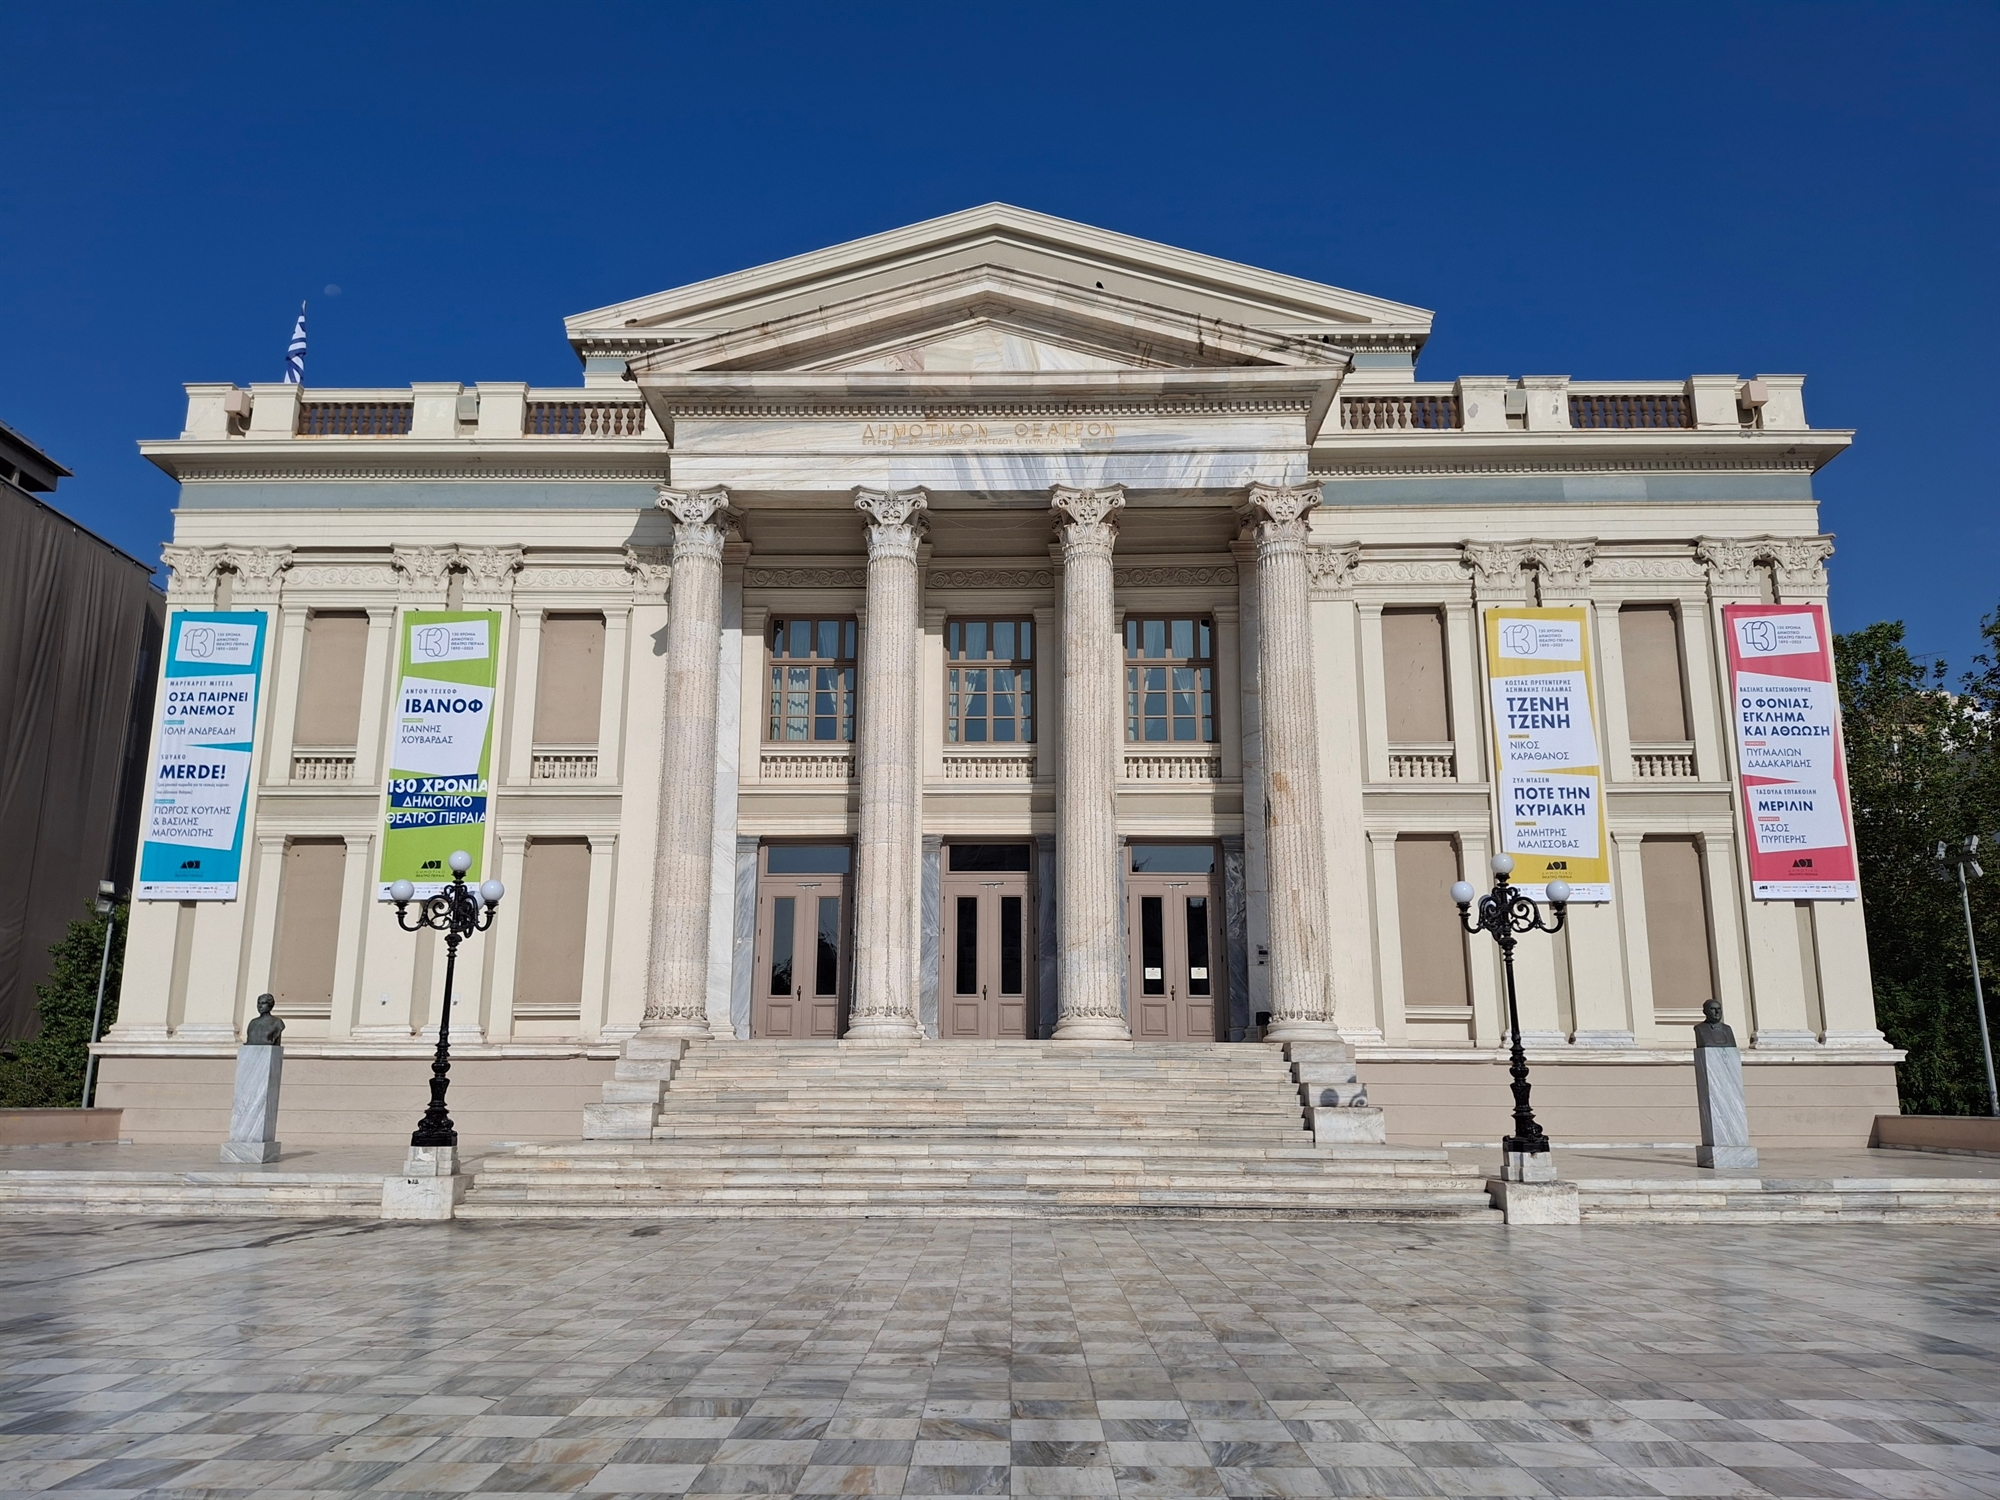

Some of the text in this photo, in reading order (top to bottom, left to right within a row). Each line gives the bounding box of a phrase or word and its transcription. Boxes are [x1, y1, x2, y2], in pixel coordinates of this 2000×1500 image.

[862, 422, 1116, 438] ΔΗΜΟΤΙΚΟΝ ΘΕΑΤΡΟΝ
[168, 691, 249, 702] ΟΣΑ ΠΑΙΡΝΕΙ
[405, 698, 484, 713] ΙΒΑΝΟΦ
[1506, 696, 1569, 712] ΤΖΕΝΗ
[1741, 698, 1814, 710] Ο ΦΟΝΙΑΣ,
[167, 705, 235, 715] Ο ΑΝΕΜΟΣ
[1507, 713, 1571, 729] ΤΖΕΝΗ
[1743, 712, 1806, 722] ΕΓΚΛΗΜΑ
[164, 726, 236, 736] ΙΟΛΗ ΑΝΔΡΕΑΔΗ
[402, 724, 442, 733] ΓΙΑΝΝΗΣ
[1744, 725, 1830, 736] ΚΑΙ ΑΘΩΩΣΗ
[401, 736, 453, 744] ΧΟΥΒΑΡΔΑΣ
[1510, 740, 1540, 750] ΝΙΚΟΣ
[1511, 752, 1570, 760] ΚΑΡΑΘΑΝΟΣ
[1746, 748, 1802, 756] ΠΥΓΜΑΛΙΩΝ
[1747, 759, 1812, 768] ΔΑΔΑΚΑΡΙΔΗΣ
[159, 764, 226, 780] MERDE!
[388, 778, 488, 793] 130 ΧΡΟΝΙΑ
[1514, 787, 1590, 800] ΠΟΤΕ ΤΗΝ
[402, 795, 473, 807] ΔΗΜΟΤΙΚΟ
[154, 806, 232, 815] ΓΙΩΡΓΟΣ ΚΟΥΤΛΗΣ
[1515, 803, 1586, 816] ΚΥΡΙΑΚΗ
[1758, 801, 1814, 812] ΜΕΡΙΛΙΝ
[152, 817, 199, 826] & ΒΑΣΙΛΗΣ
[385, 811, 486, 824] ΘΕΑΤΡΟ ΠΕΙΡΑΙΑ
[151, 828, 214, 837] ΜΑΓΟΥΛΙΩΤΗΣ
[1516, 828, 1567, 837] ΔΗΜΗΤΡΗΣ
[1759, 823, 1790, 832] ΤΑΣΟΣ
[1518, 839, 1580, 848] ΜΑΛΙΣΣΟΒΑΣ
[1761, 835, 1807, 844] ΠΥΡΓΙΕΡΗΣ
